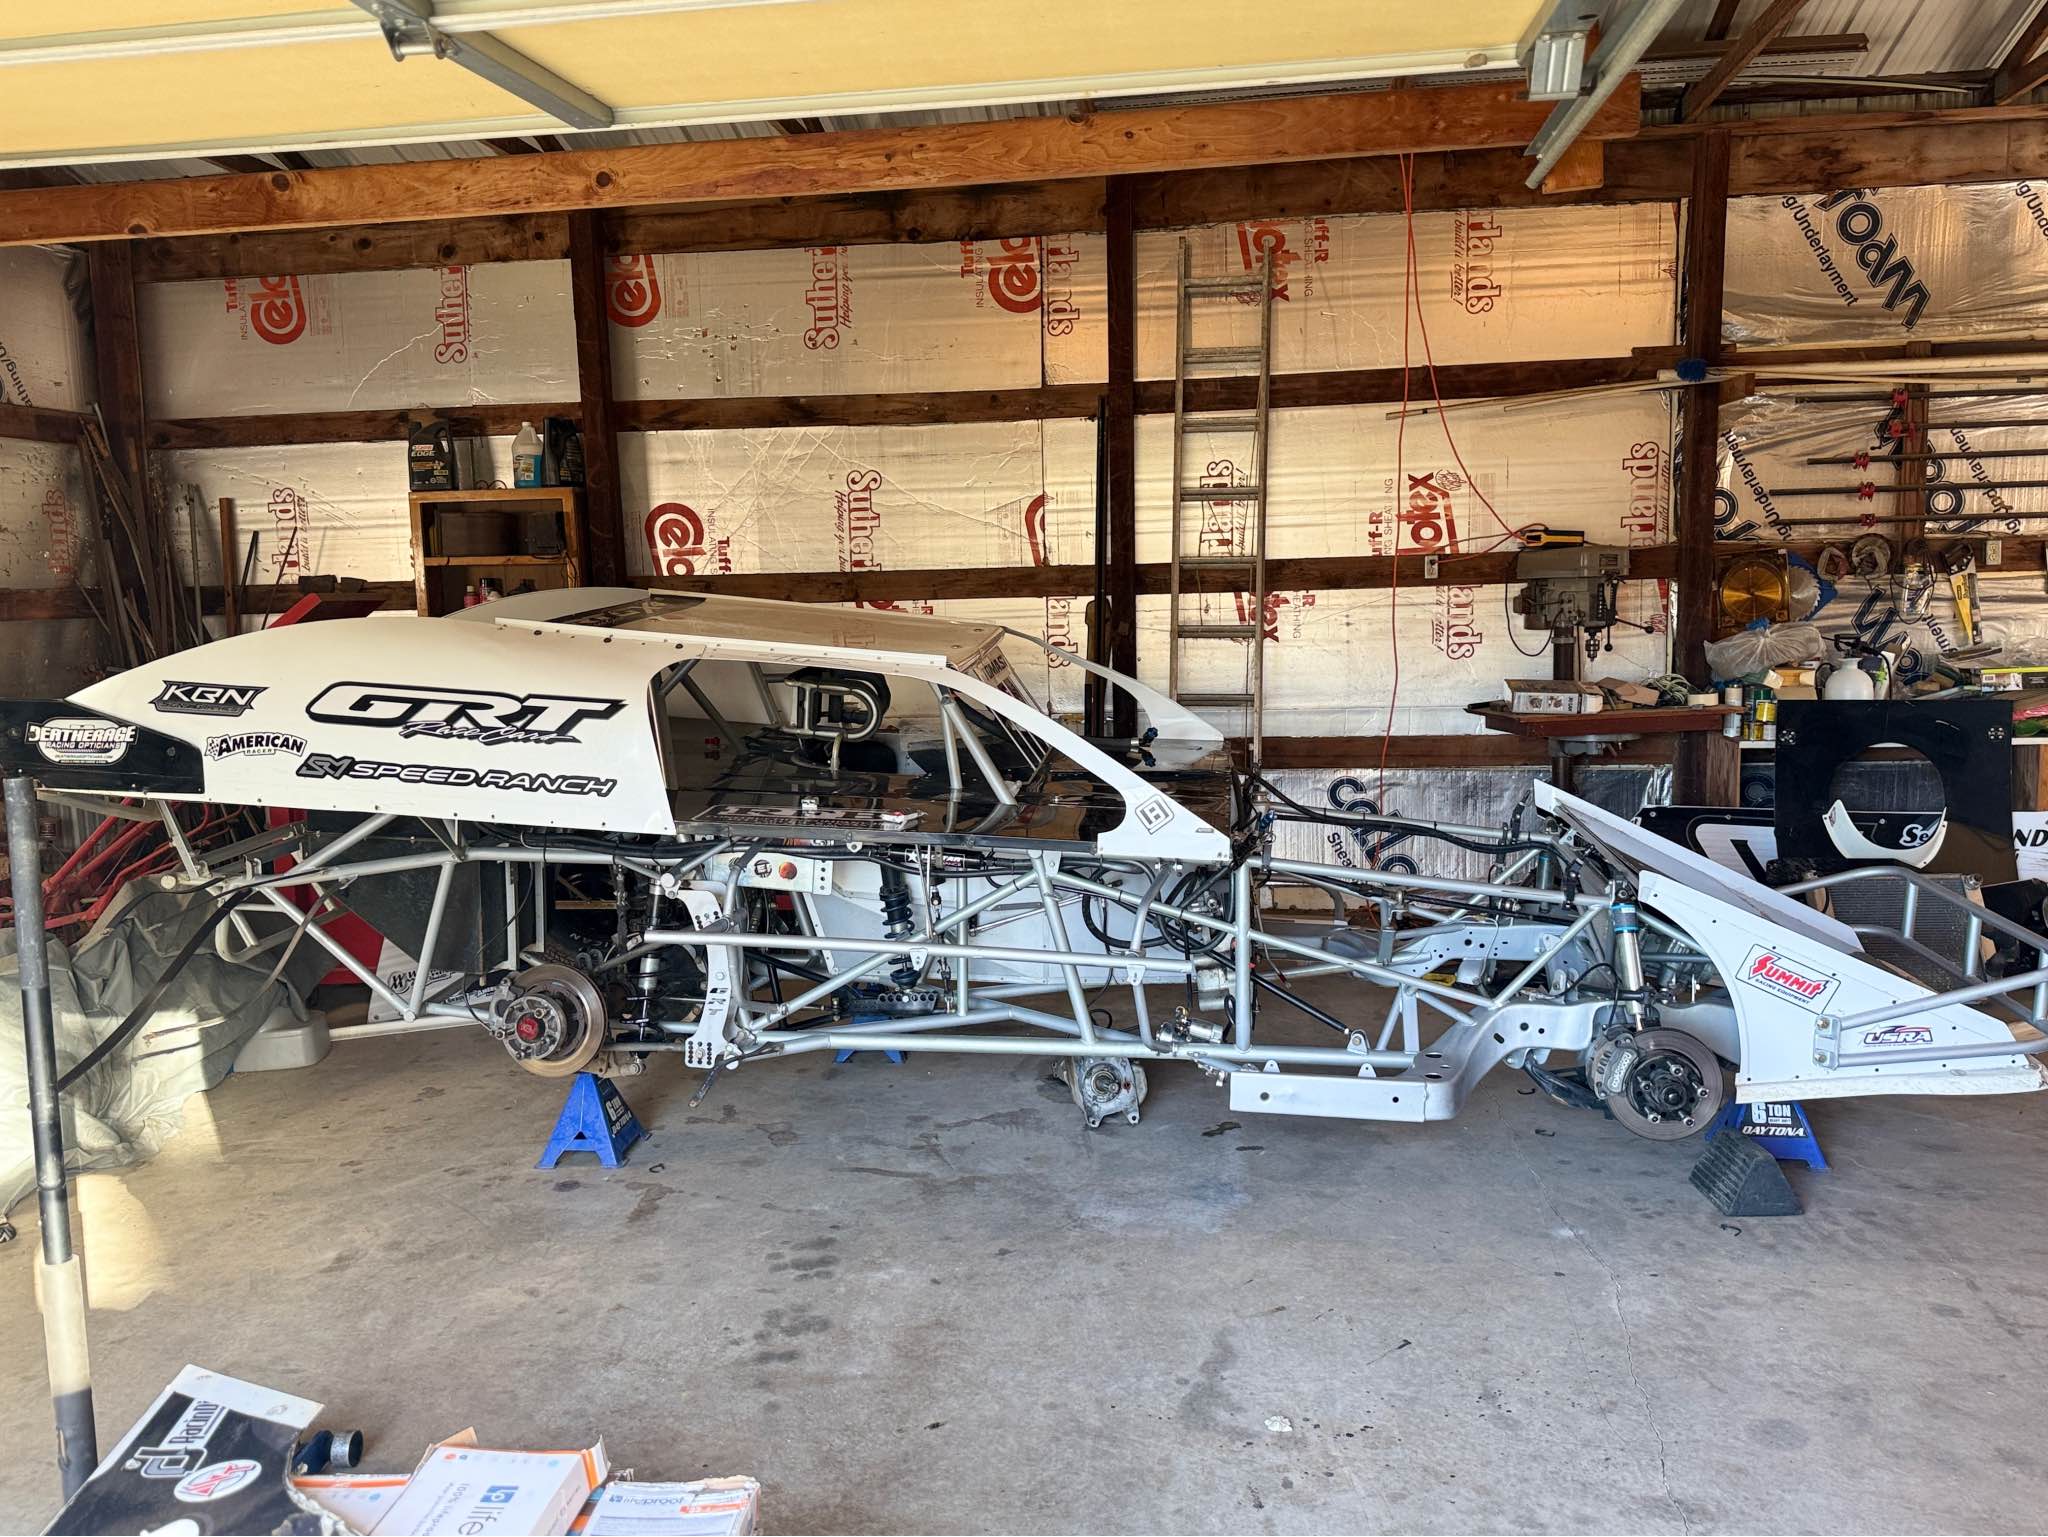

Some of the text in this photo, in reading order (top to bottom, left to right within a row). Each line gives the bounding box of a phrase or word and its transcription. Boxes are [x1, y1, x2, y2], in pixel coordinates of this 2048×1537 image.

[840, 283, 853, 329] Helping
[833, 490, 848, 532] Helping
[305, 681, 630, 737] GRT
[28, 725, 137, 742] DEATHERAGE
[400, 719, 583, 746] Race Cars
[45, 741, 121, 750] RACING OPTICIANS
[217, 734, 304, 757] AMERICAN
[349, 763, 475, 786] SPEED
[480, 771, 617, 797] RANCH
[1755, 978, 1777, 991] RACING
[1864, 1030, 1934, 1045] USRA
[1751, 1102, 1791, 1124] 6 TON
[1742, 1125, 1806, 1137] DAYTONA
